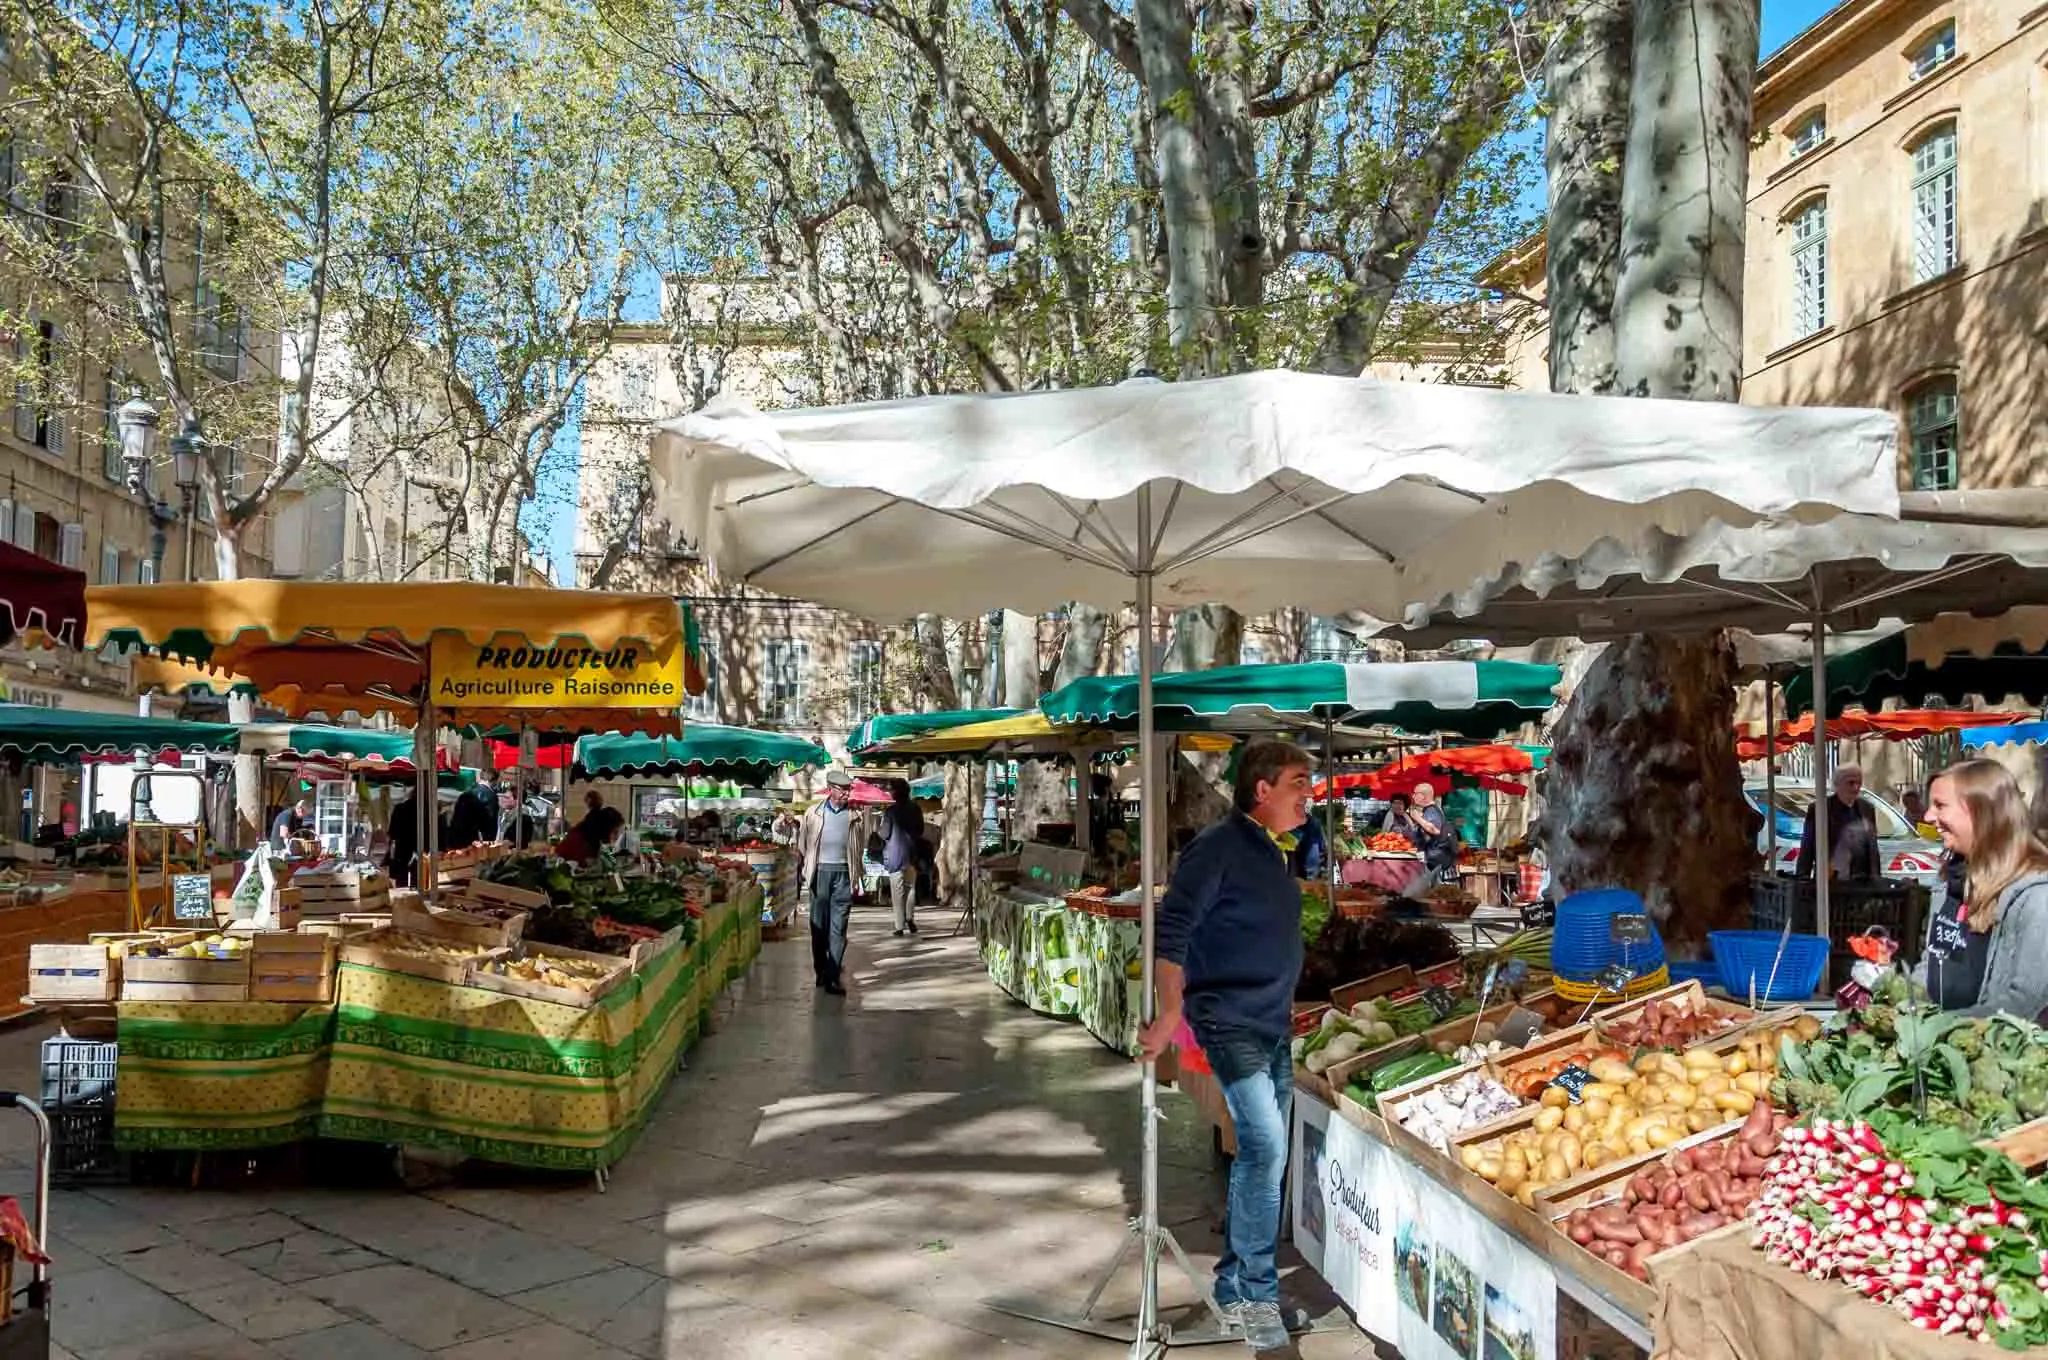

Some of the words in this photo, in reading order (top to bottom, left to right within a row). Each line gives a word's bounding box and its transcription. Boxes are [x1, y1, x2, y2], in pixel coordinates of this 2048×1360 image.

[477, 647, 639, 670] PRODUCTEUR
[440, 677, 555, 698] Agriculture
[564, 677, 675, 696] Raisonnée
